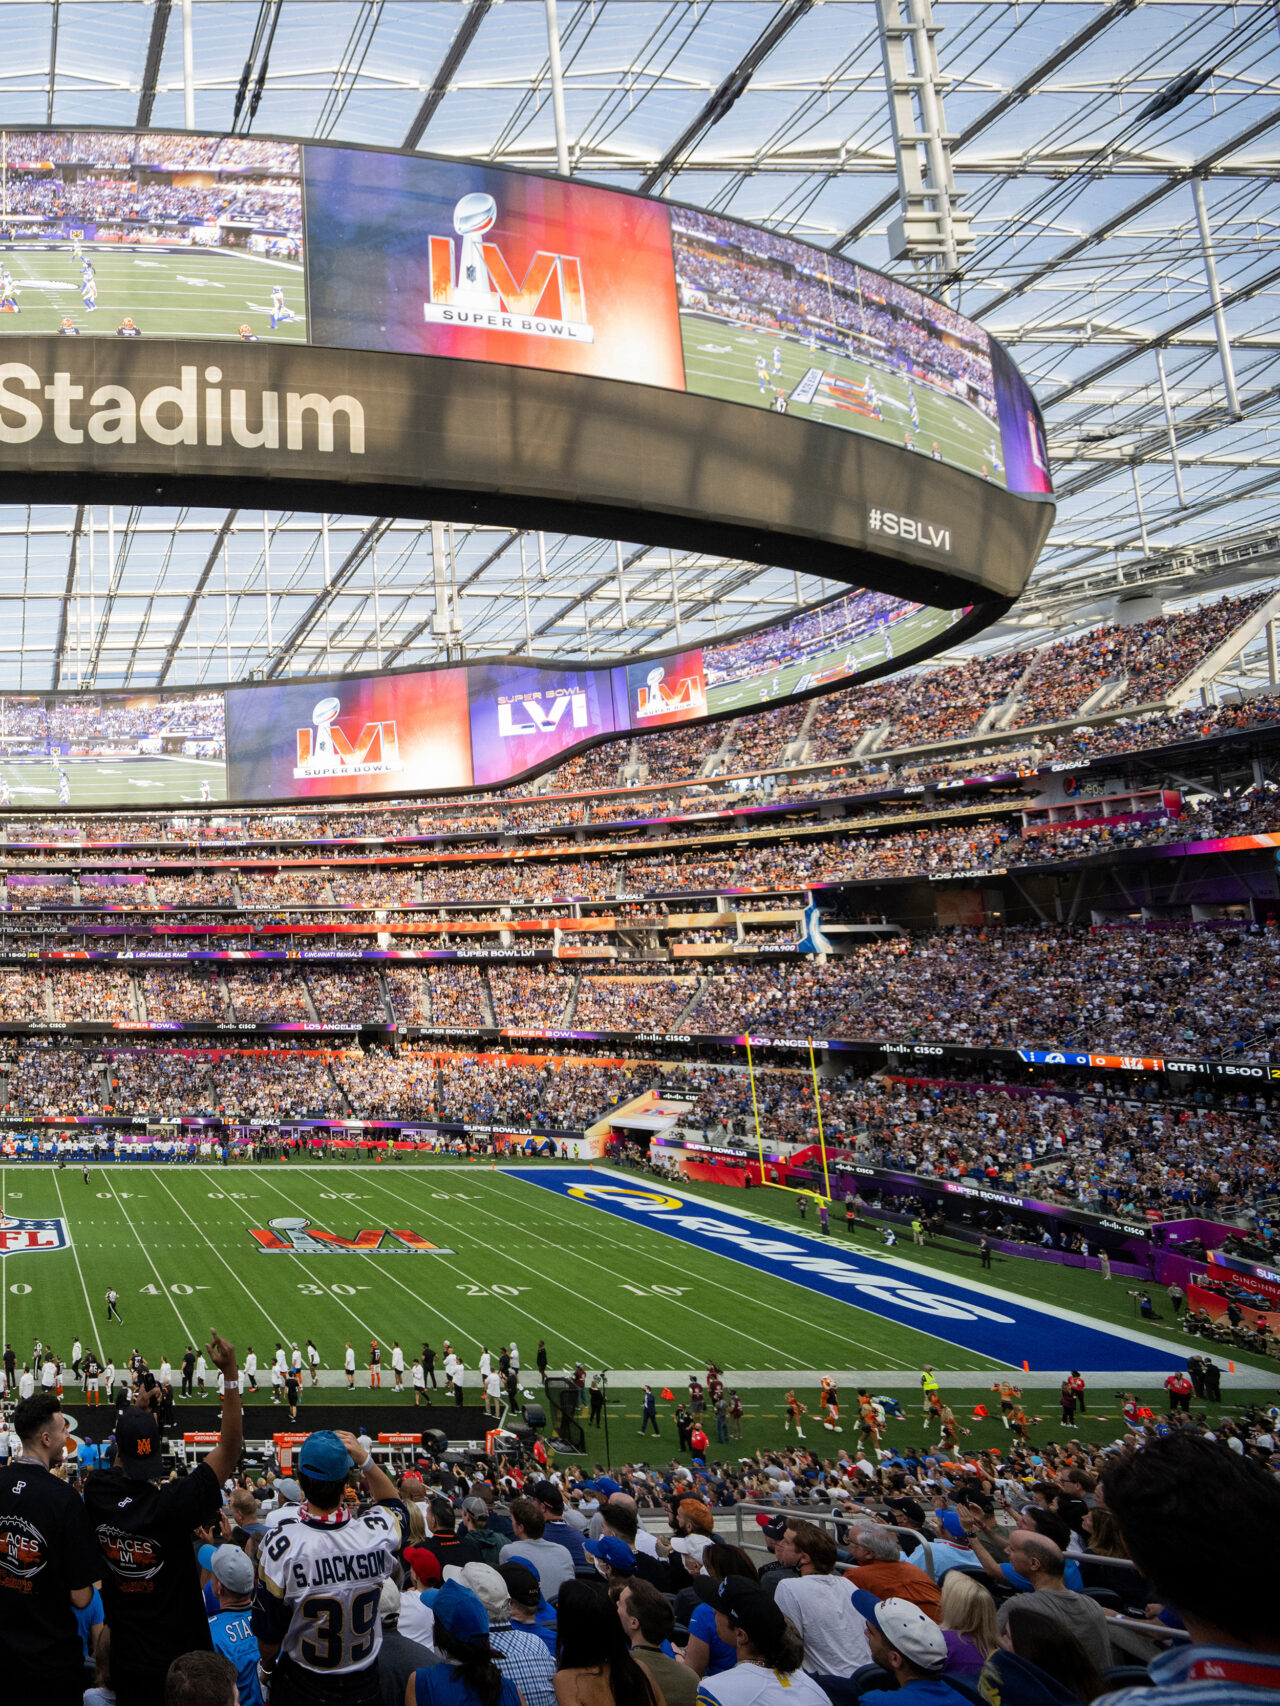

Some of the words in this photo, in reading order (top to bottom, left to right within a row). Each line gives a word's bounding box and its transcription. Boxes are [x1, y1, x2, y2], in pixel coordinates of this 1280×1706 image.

[442, 309, 512, 328] SUPER
[521, 319, 577, 337] BOWL
[869, 508, 950, 551] #SBLVI
[497, 691, 543, 704] SUPER
[545, 687, 586, 699] BOWL
[497, 693, 588, 737] LVI
[304, 765, 348, 776] SUPER
[353, 763, 393, 774] BOWL
[1051, 760, 1091, 773] BENGALS
[904, 785, 925, 793] RAMS
[929, 872, 951, 880] LOS
[953, 869, 1007, 879] ANGELES
[507, 1029, 543, 1037] SUPER
[666, 1034, 690, 1042] CISCO
[749, 1038, 770, 1046] LOS
[914, 1047, 943, 1055] CISCO
[1077, 1056, 1086, 1064] 0
[1096, 1057, 1105, 1066] 0
[1167, 1062, 1197, 1072] QTR
[1217, 1065, 1263, 1077] 15:00
[250, 1118, 280, 1126] BENGALS
[687, 1143, 711, 1152] SUPER
[712, 1146, 735, 1154] BOWL
[856, 1167, 874, 1175] CISCO
[948, 1184, 979, 1198] SUPER
[980, 1191, 1008, 1204] BOWL
[1008, 1197, 1023, 1207] LVI
[1124, 1225, 1145, 1236] CISCO
[661, 1212, 1017, 1322] RAMS
[139, 1283, 195, 1295] 40
[297, 1283, 358, 1296] 30
[456, 1283, 521, 1296] 20
[620, 1284, 684, 1297] 10
[99, 1535, 154, 1554] PLACES
[8, 1546, 19, 1558] LVI
[119, 1551, 134, 1563] LVI
[225, 1616, 254, 1643] STA
[300, 1583, 383, 1669] 39
